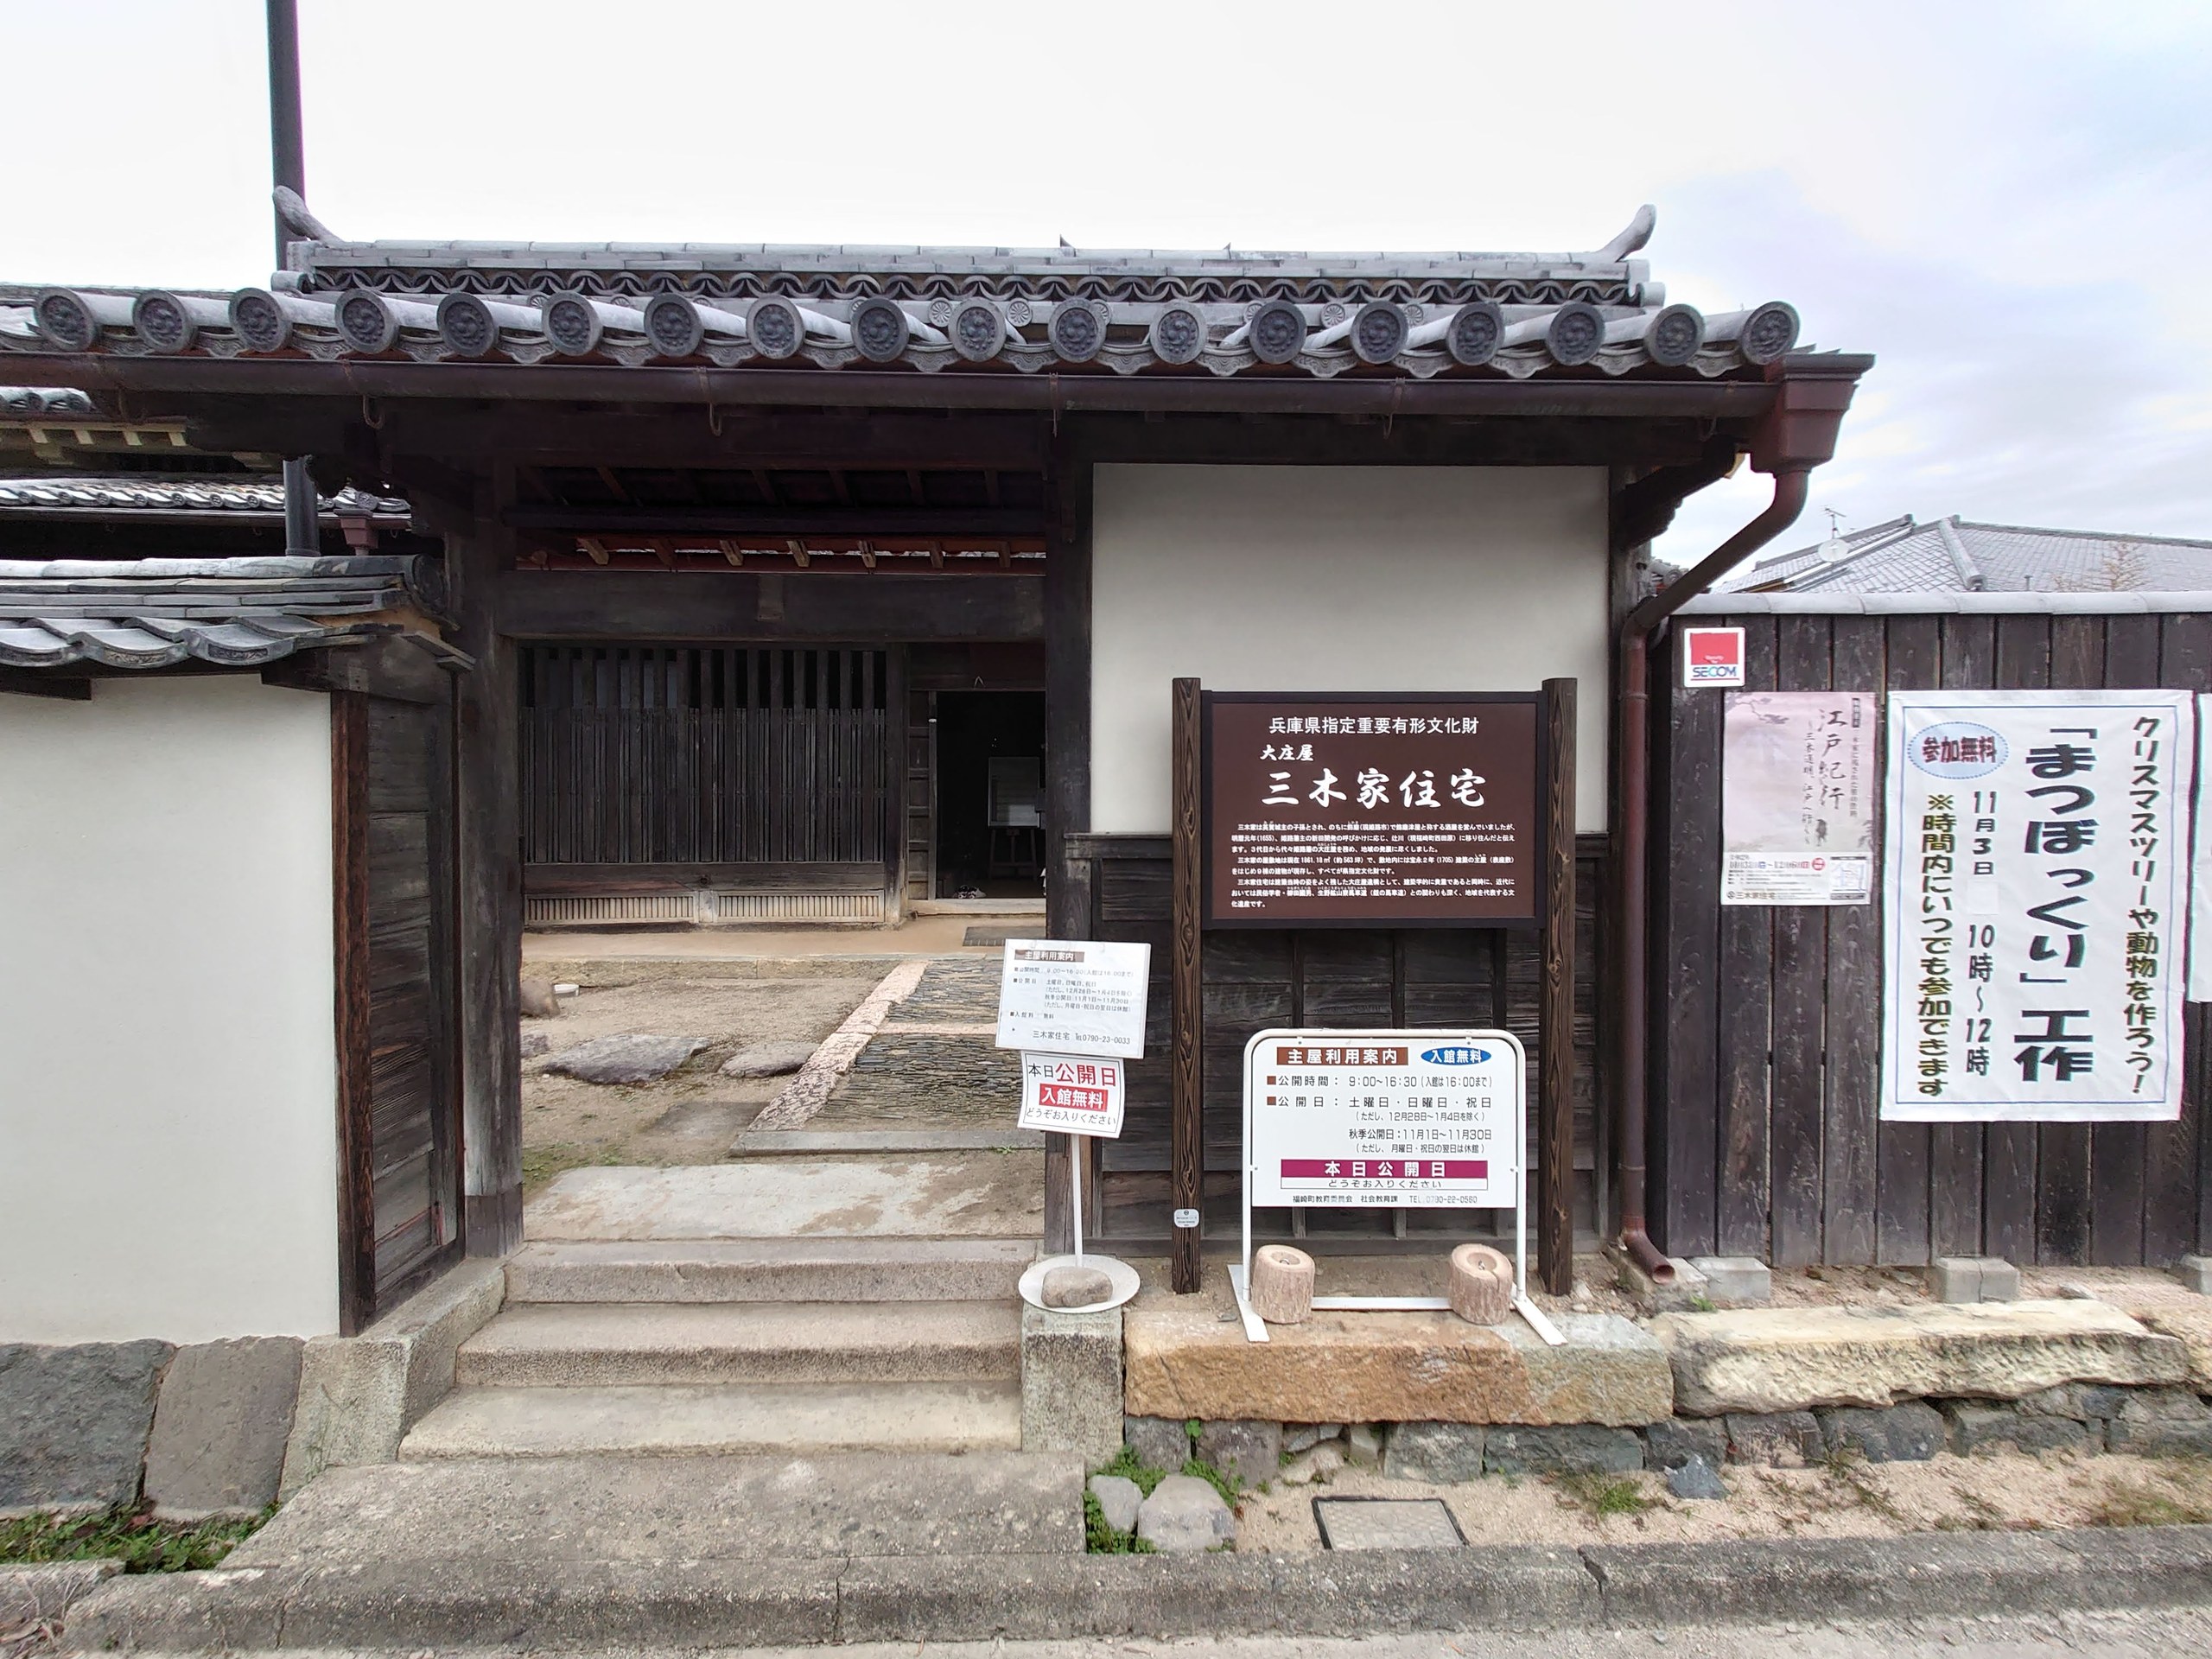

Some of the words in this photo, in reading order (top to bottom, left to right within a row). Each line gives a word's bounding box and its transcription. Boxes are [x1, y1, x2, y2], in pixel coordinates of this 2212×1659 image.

[1693, 666, 1737, 677] SECOM
[1269, 716, 1479, 734] 兵庫県指定重要有形文化財
[1260, 744, 1314, 762] 大庄屋
[1922, 736, 1997, 764] 参加無料
[1262, 767, 1486, 810] 三木家住宅
[1973, 791, 1997, 876] 11月3日
[2013, 727, 2100, 1083] 「まつぼっくり」工作
[2123, 715, 2161, 1094] クリスマスツリーや動物を作ろう！
[1024, 950, 1075, 961] 主屋利用案内
[1033, 1031, 1071, 1040] 三木家住宅
[1287, 1048, 1398, 1065] 主屋利用案内
[1430, 1050, 1482, 1064] 入館無料
[1028, 1063, 1116, 1087] 本日公開日
[1040, 1087, 1103, 1109] 入館無料
[1026, 1108, 1116, 1126] どうぞお入りください
[1325, 1161, 1446, 1177] 本日公開日
[1328, 1179, 1441, 1189] どうぞお入りください
[1360, 1195, 1398, 1204] 社会教育課
